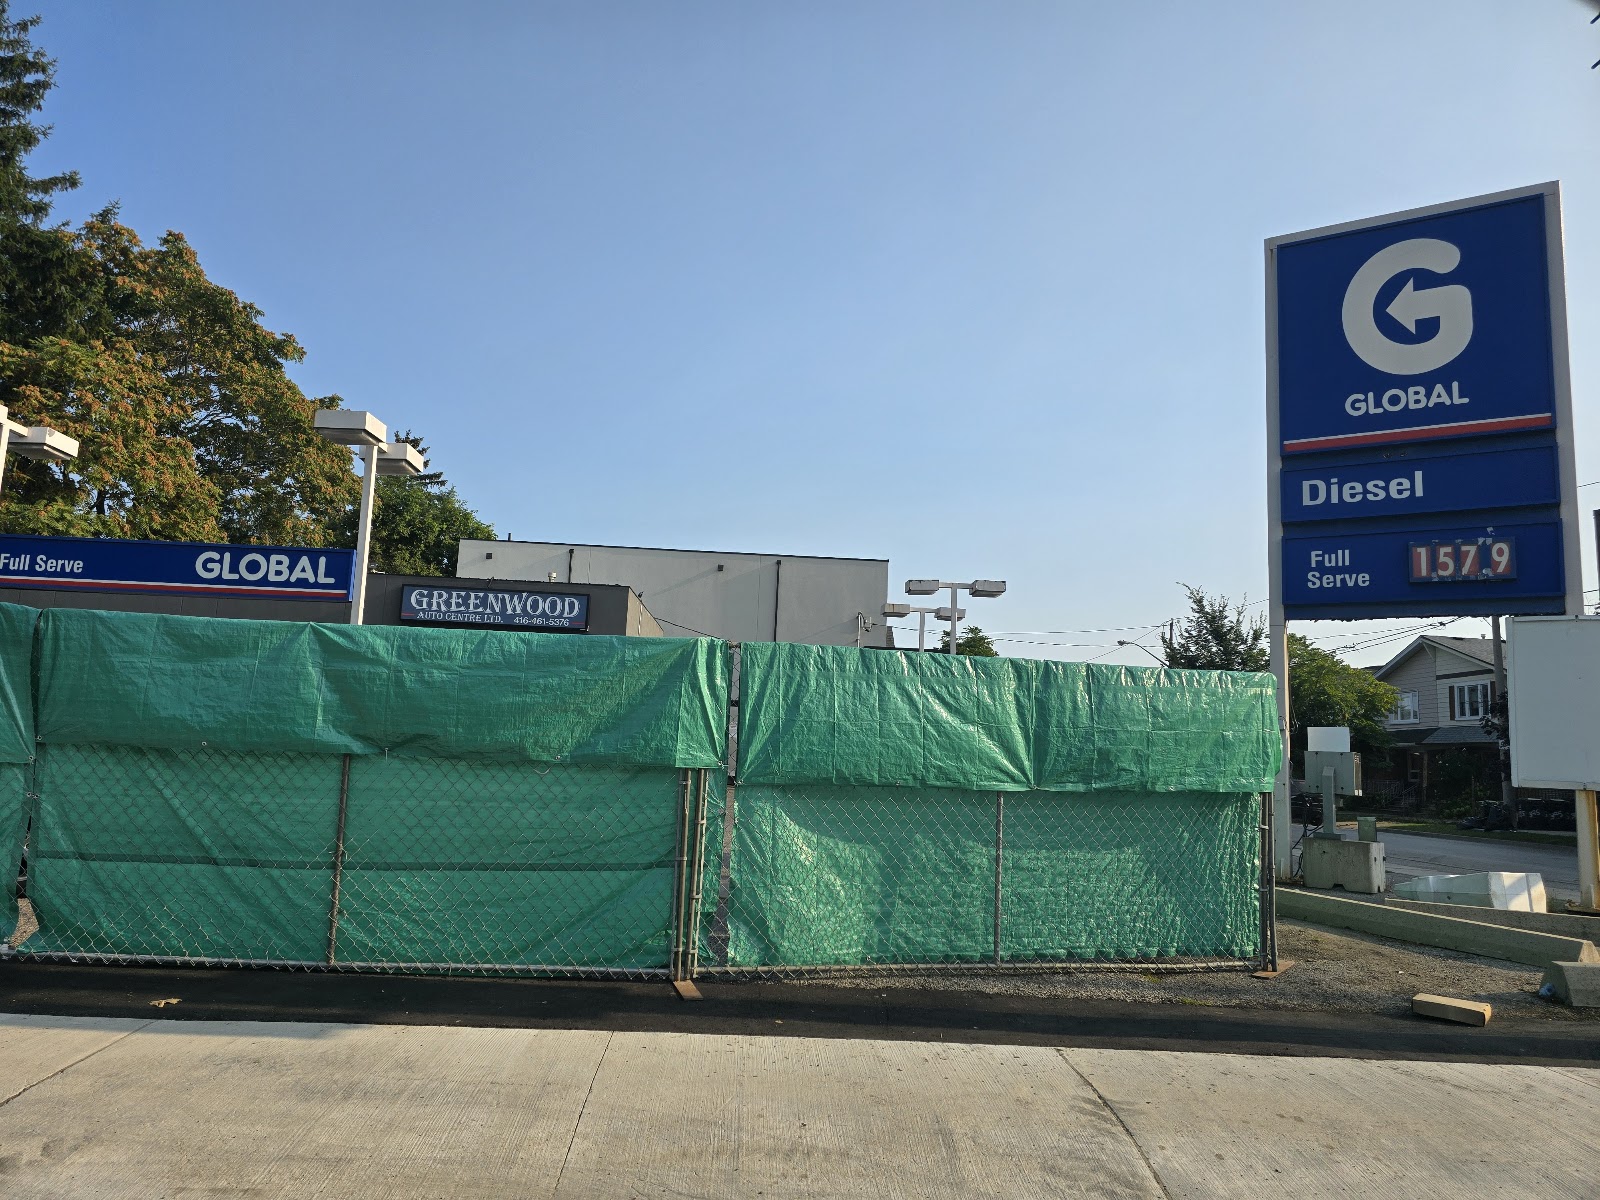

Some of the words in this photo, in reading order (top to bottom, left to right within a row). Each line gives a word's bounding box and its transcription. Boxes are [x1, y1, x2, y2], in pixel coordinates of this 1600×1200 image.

[1344, 380, 1470, 417] GLOBAL
[1301, 470, 1424, 506] Diesel
[0, 553, 31, 571] Full
[35, 554, 84, 573] Serve
[195, 551, 336, 584] GLOBAL
[1310, 549, 1351, 568] Full
[1307, 570, 1370, 589] Serve
[410, 589, 581, 618] GREENWOOD
[416, 611, 443, 621] AUTO
[445, 612, 482, 623] CENTRE
[483, 613, 504, 624] LTD.
[513, 616, 570, 627] 416-461-5376
